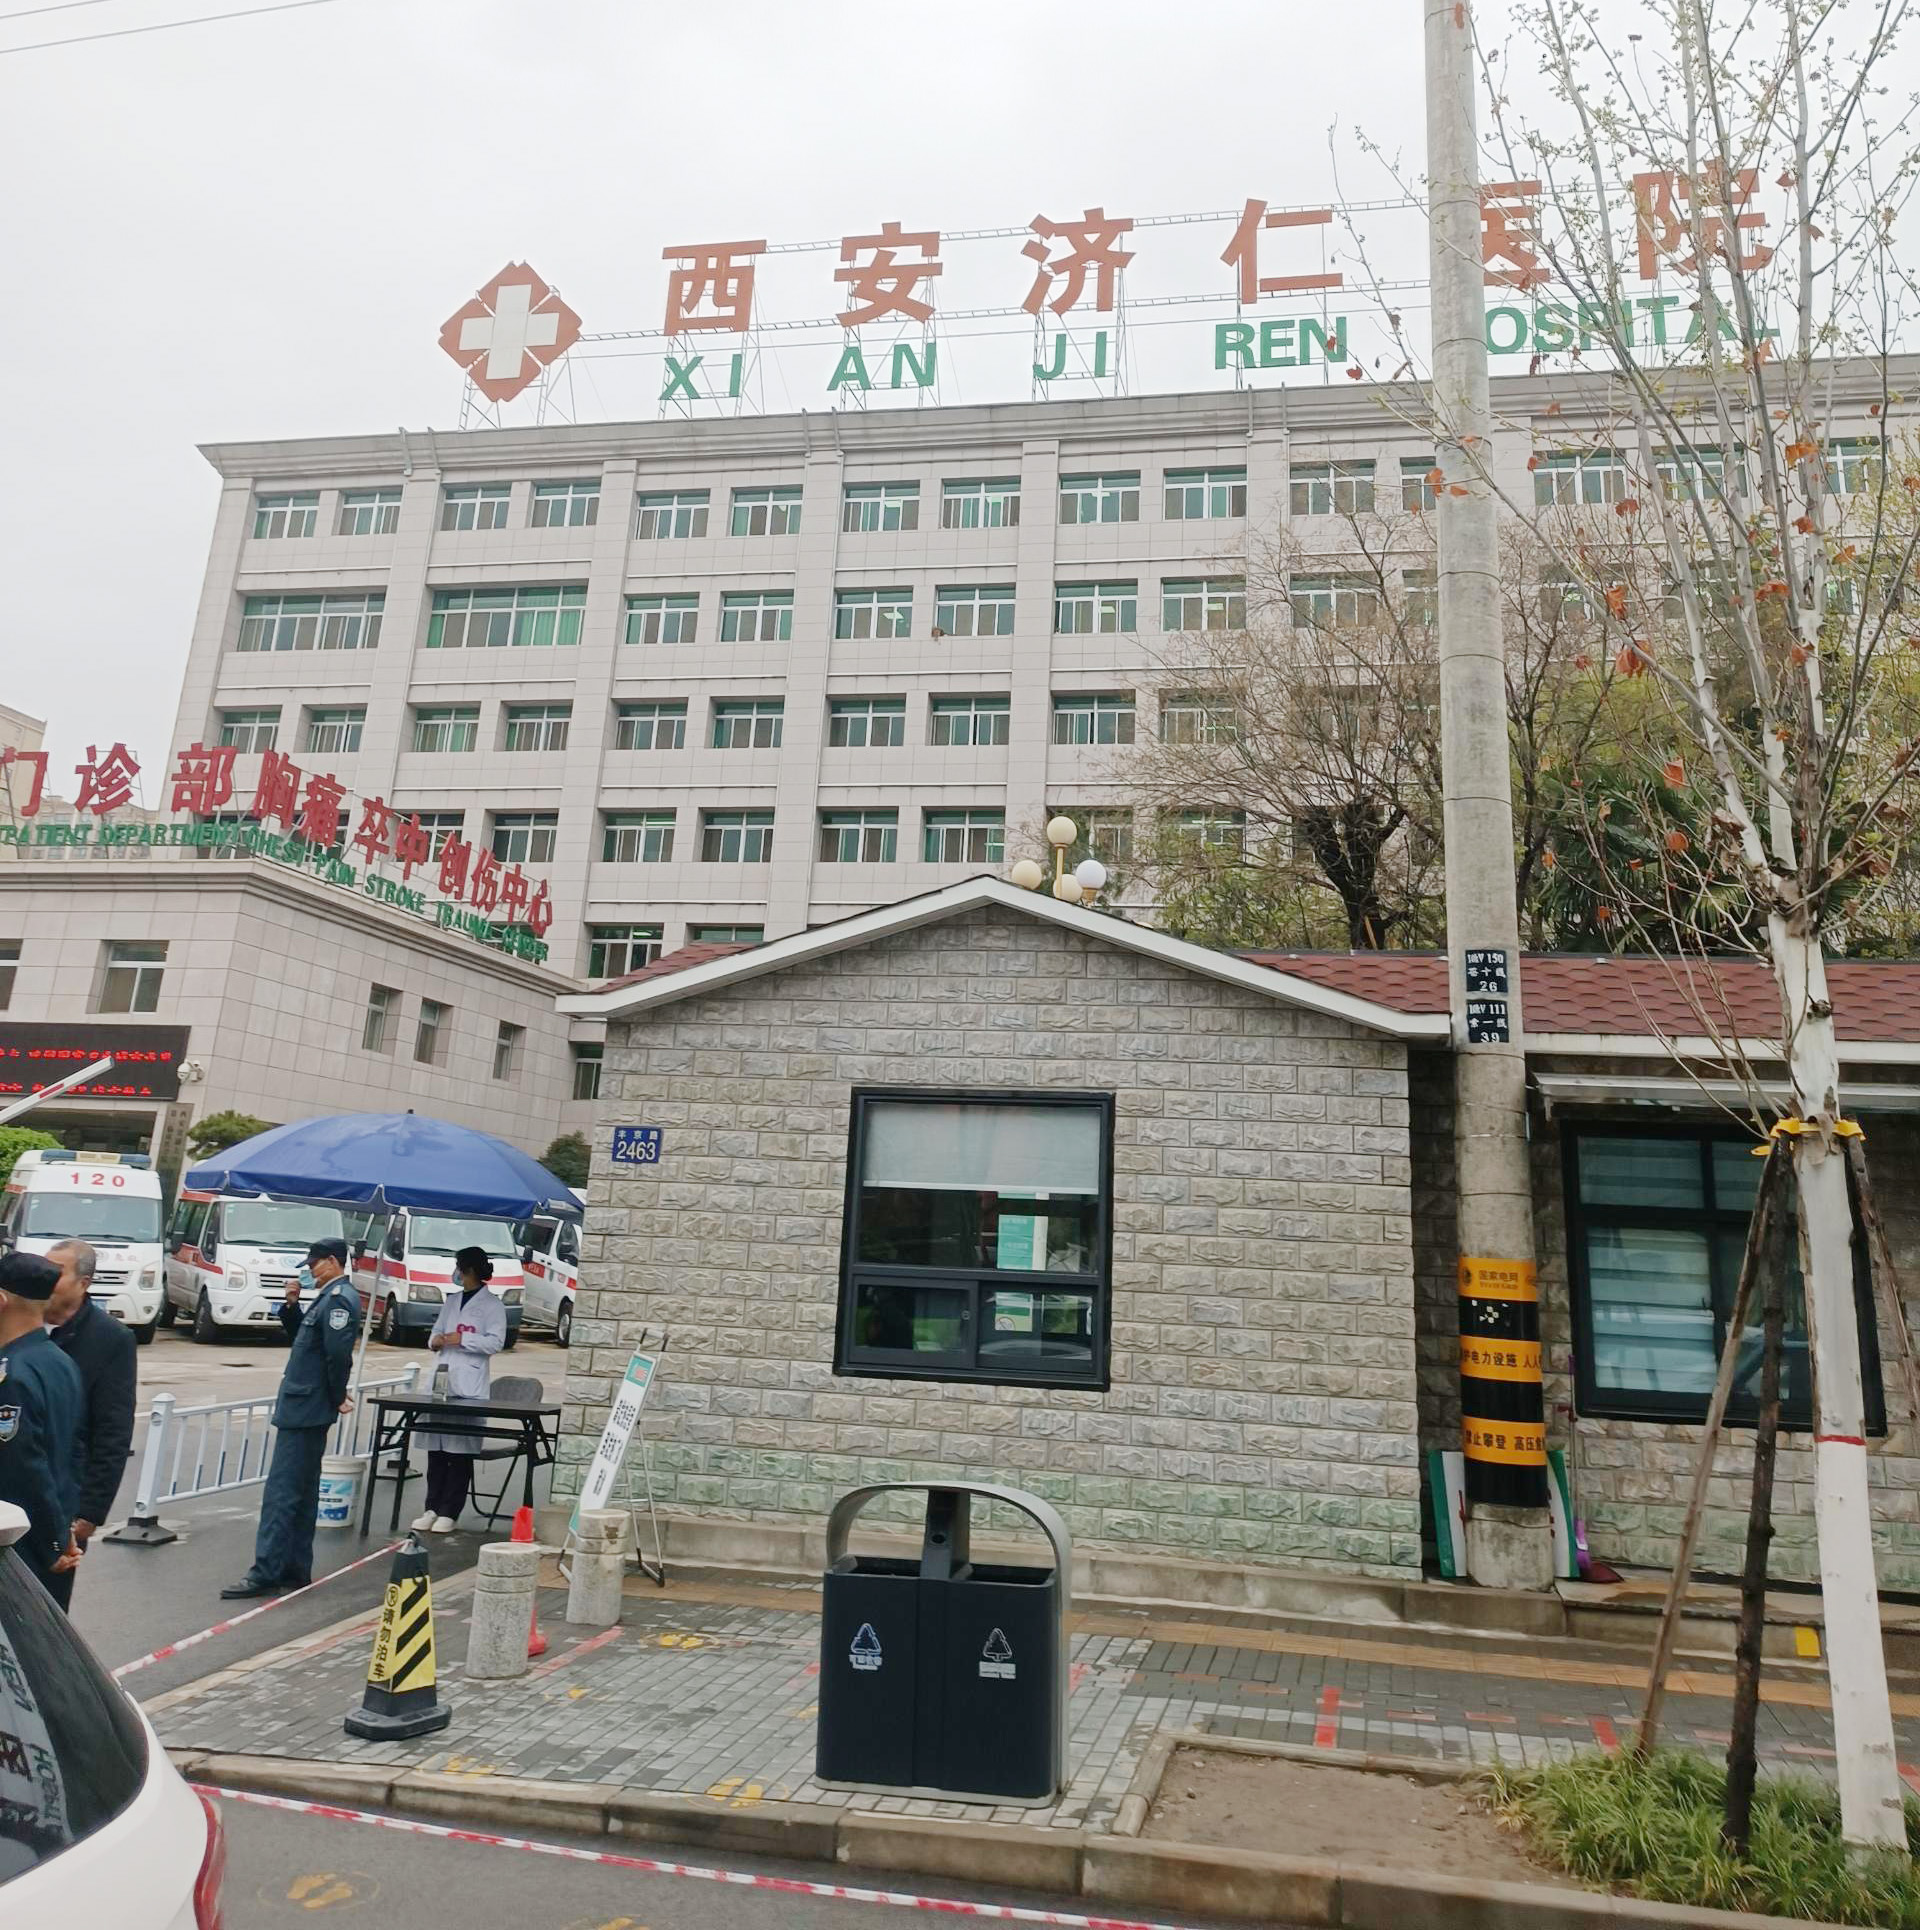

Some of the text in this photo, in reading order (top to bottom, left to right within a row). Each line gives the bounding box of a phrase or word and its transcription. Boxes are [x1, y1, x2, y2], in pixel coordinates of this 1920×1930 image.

[659, 295, 1780, 400] XI AN JI REN OSPITAL
[100, 823, 241, 845] DEPARTMENT
[253, 749, 553, 939] 胸痛卒中创伤中心
[365, 873, 426, 914] STROKE
[1487, 953, 1504, 964] 150
[1480, 981, 1498, 991] 26
[1490, 1004, 1506, 1014] 111
[616, 1141, 656, 1160] 2463
[70, 1172, 125, 1187] 120
